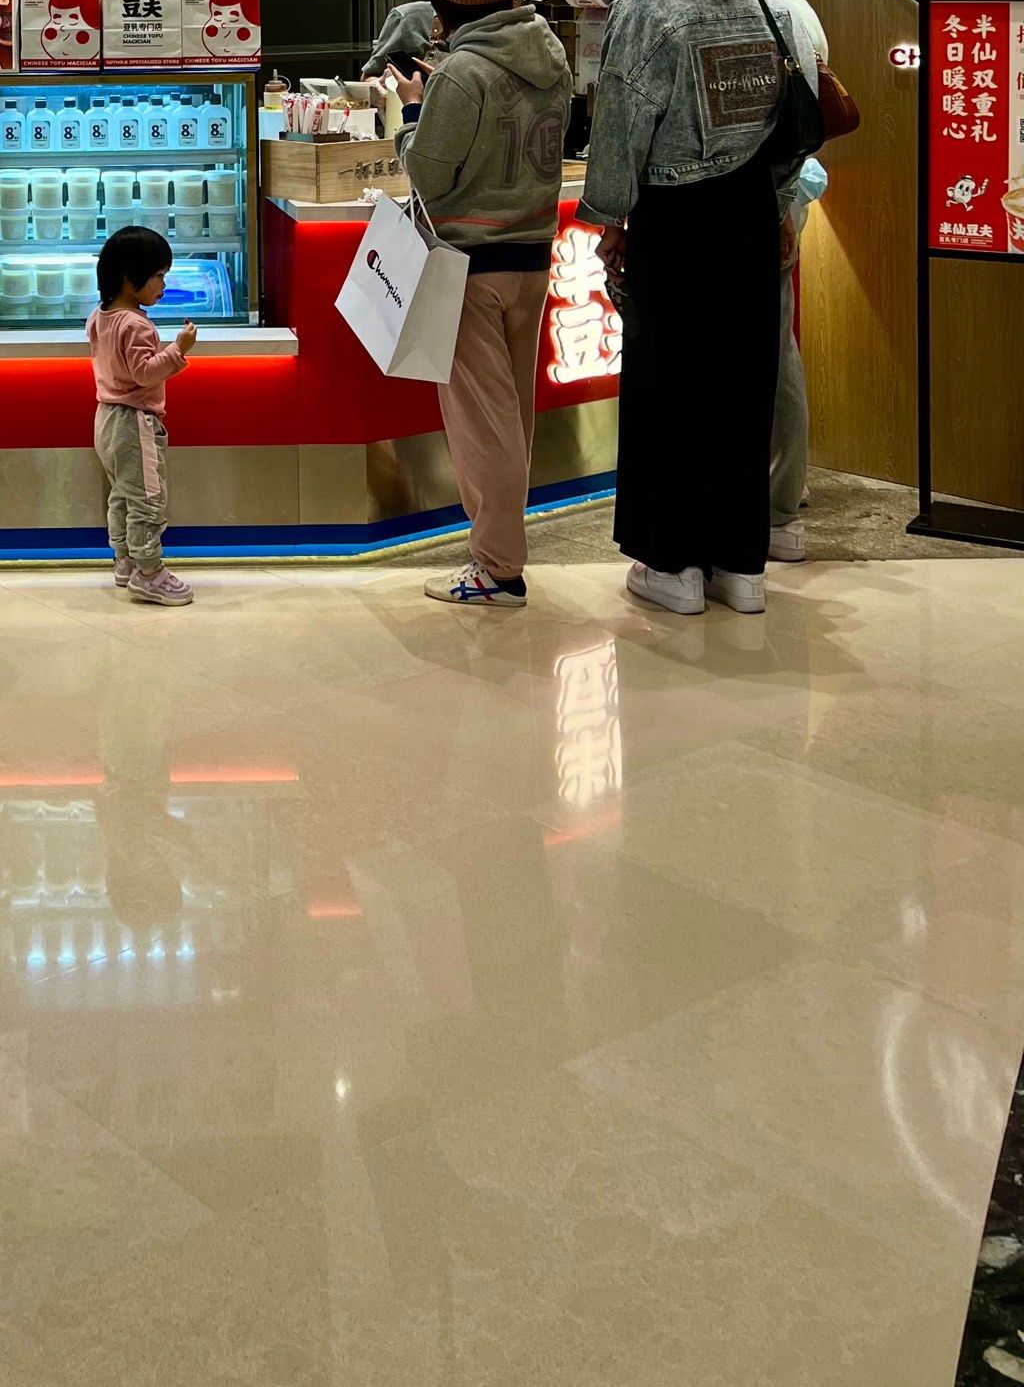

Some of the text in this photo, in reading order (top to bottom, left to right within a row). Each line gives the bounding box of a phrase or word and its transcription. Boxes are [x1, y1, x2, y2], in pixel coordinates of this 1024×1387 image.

[123, 23, 162, 32] 豆乳专门店
[942, 14, 968, 140] 冬日暖暖心
[971, 14, 998, 143] 半仙双重礼
[939, 222, 993, 237] 半仙豆夫
[367, 249, 402, 308] Champion
